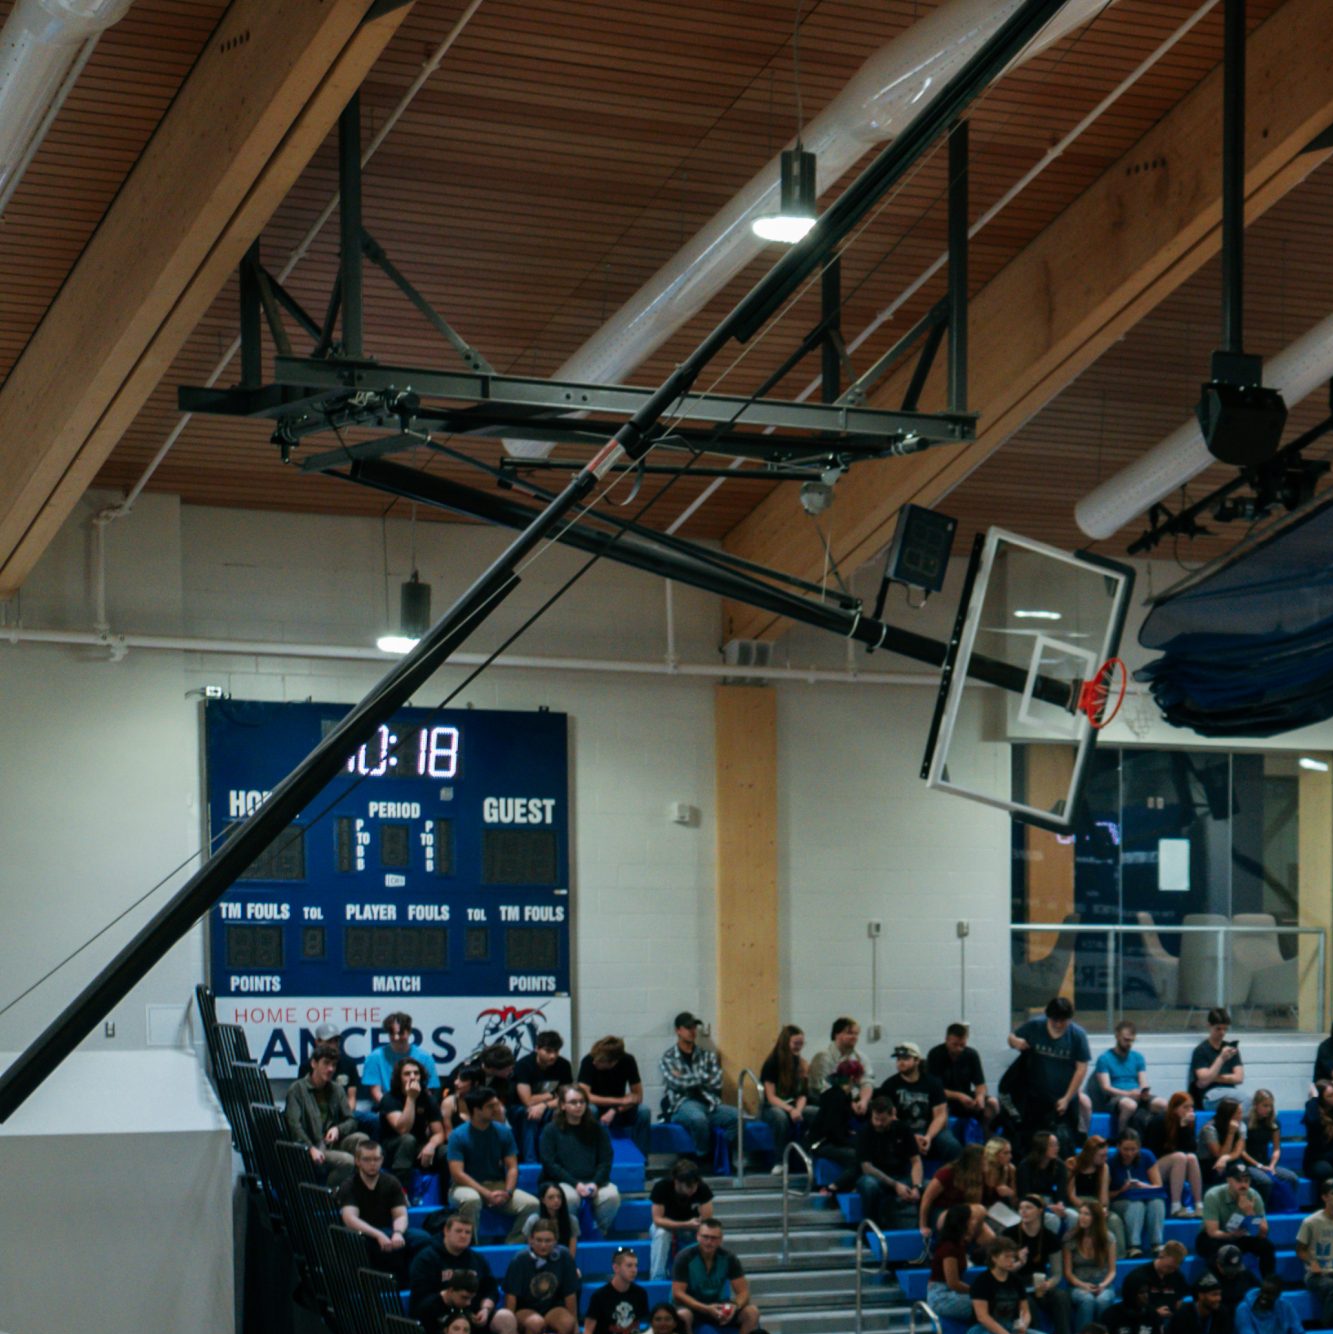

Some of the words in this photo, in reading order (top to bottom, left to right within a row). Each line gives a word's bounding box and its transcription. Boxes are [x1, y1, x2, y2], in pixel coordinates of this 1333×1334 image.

[369, 801, 421, 819] PERIOD
[483, 796, 556, 824] GUEST
[219, 902, 241, 919] TM
[247, 903, 291, 920] FOULS
[303, 907, 324, 920] TOL
[345, 904, 397, 921] PLAYER
[408, 904, 450, 921] FOULS
[467, 908, 487, 921] TOL
[500, 905, 520, 921] TM
[524, 905, 565, 921] FOULS
[230, 975, 282, 992] POINTS
[372, 975, 421, 992] MATCH
[509, 975, 556, 992] POINTS
[234, 1007, 297, 1023] HOME
[306, 1007, 333, 1023] OF
[342, 1007, 381, 1023] THE
